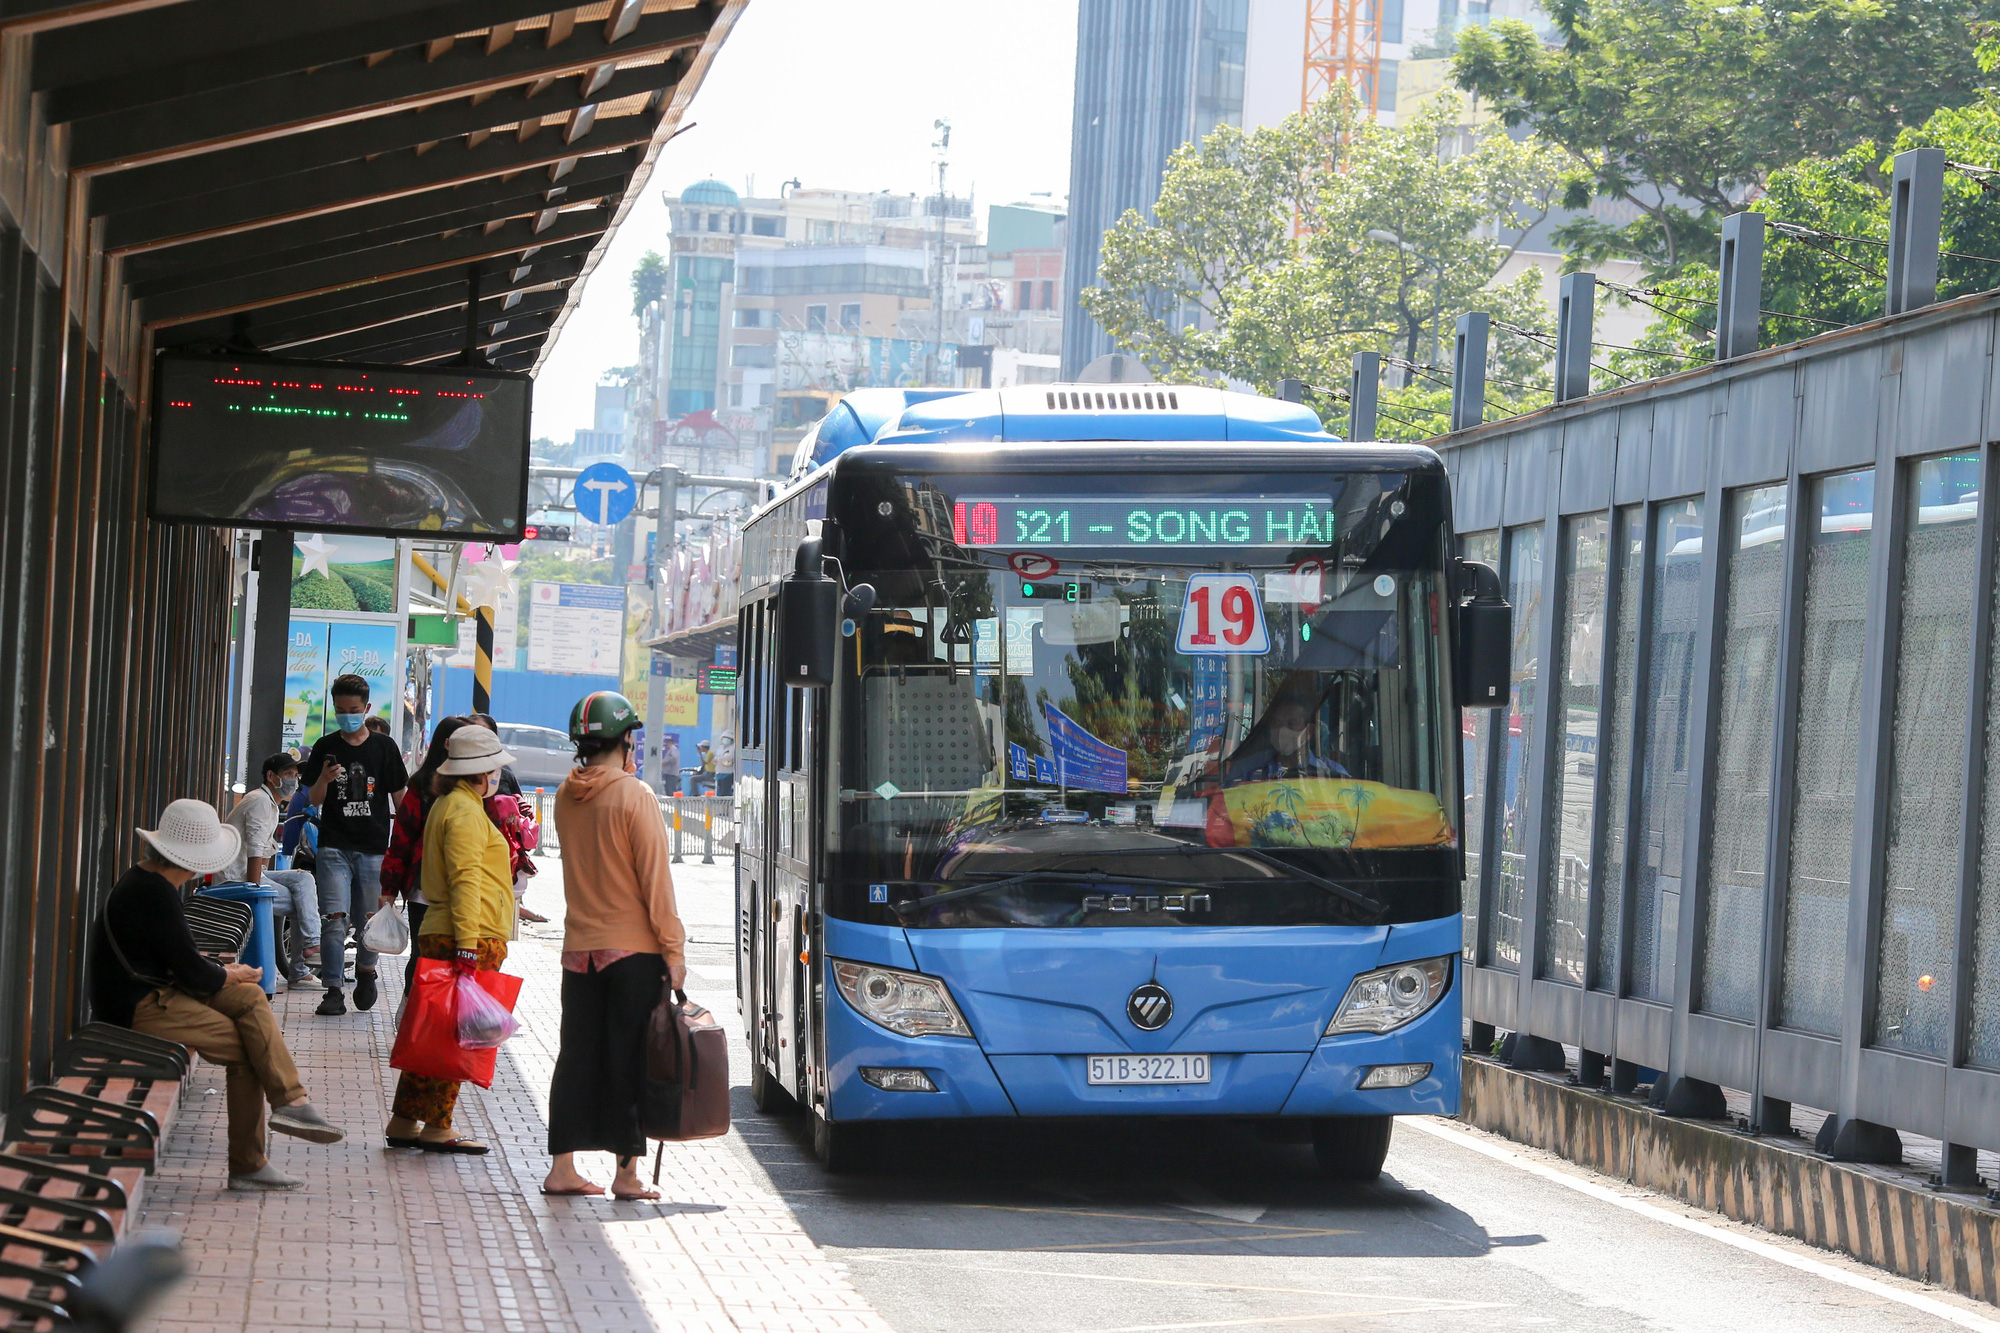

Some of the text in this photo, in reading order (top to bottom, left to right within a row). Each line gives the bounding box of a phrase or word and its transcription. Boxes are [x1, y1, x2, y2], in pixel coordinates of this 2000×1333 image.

[1127, 510, 1250, 542] SONG
[1190, 585, 1255, 646] 19
[288, 632, 313, 647] -ĐA
[341, 645, 380, 666] SÔ-ĐA
[338, 660, 387, 678] Chanh
[1082, 894, 1212, 913] FOTON
[1092, 1057, 1206, 1080] 51B-322.10
